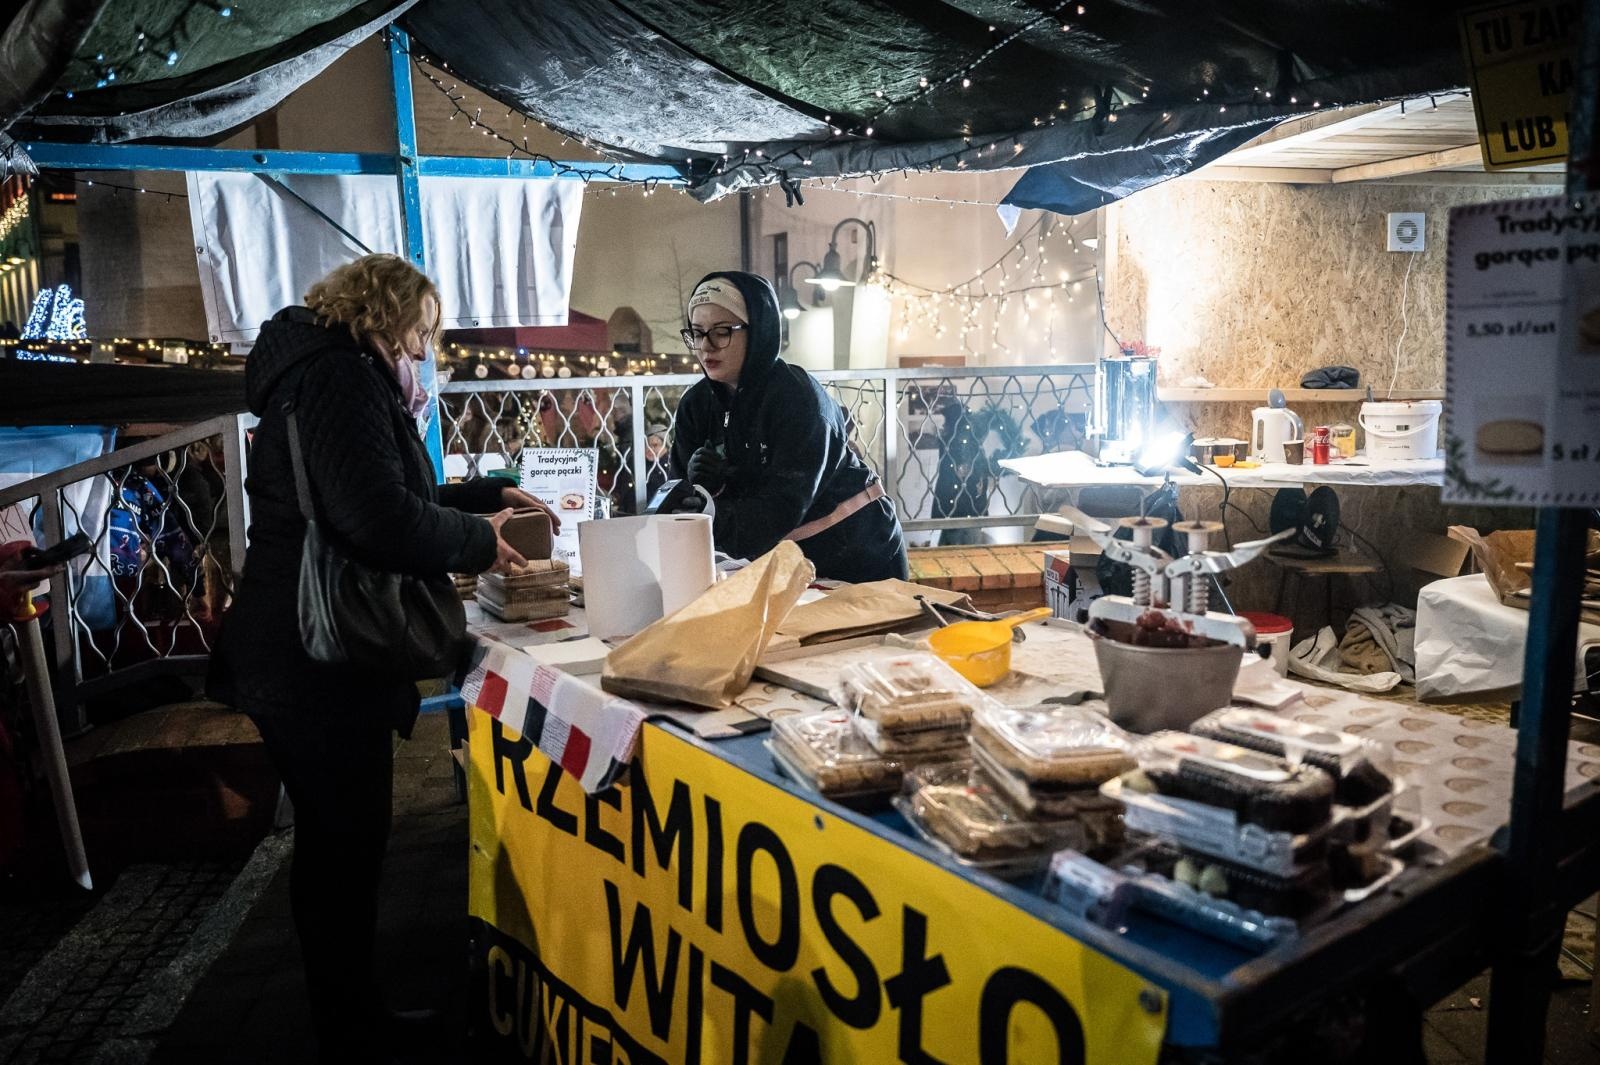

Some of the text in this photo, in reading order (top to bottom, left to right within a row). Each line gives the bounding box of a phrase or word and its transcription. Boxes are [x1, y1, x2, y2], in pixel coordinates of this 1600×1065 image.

[1475, 16, 1512, 54] TU
[1500, 115, 1557, 153] LUB
[530, 466, 582, 478] gorące pączki
[537, 455, 578, 465] Tradycyjne
[603, 879, 822, 1065] WIT
